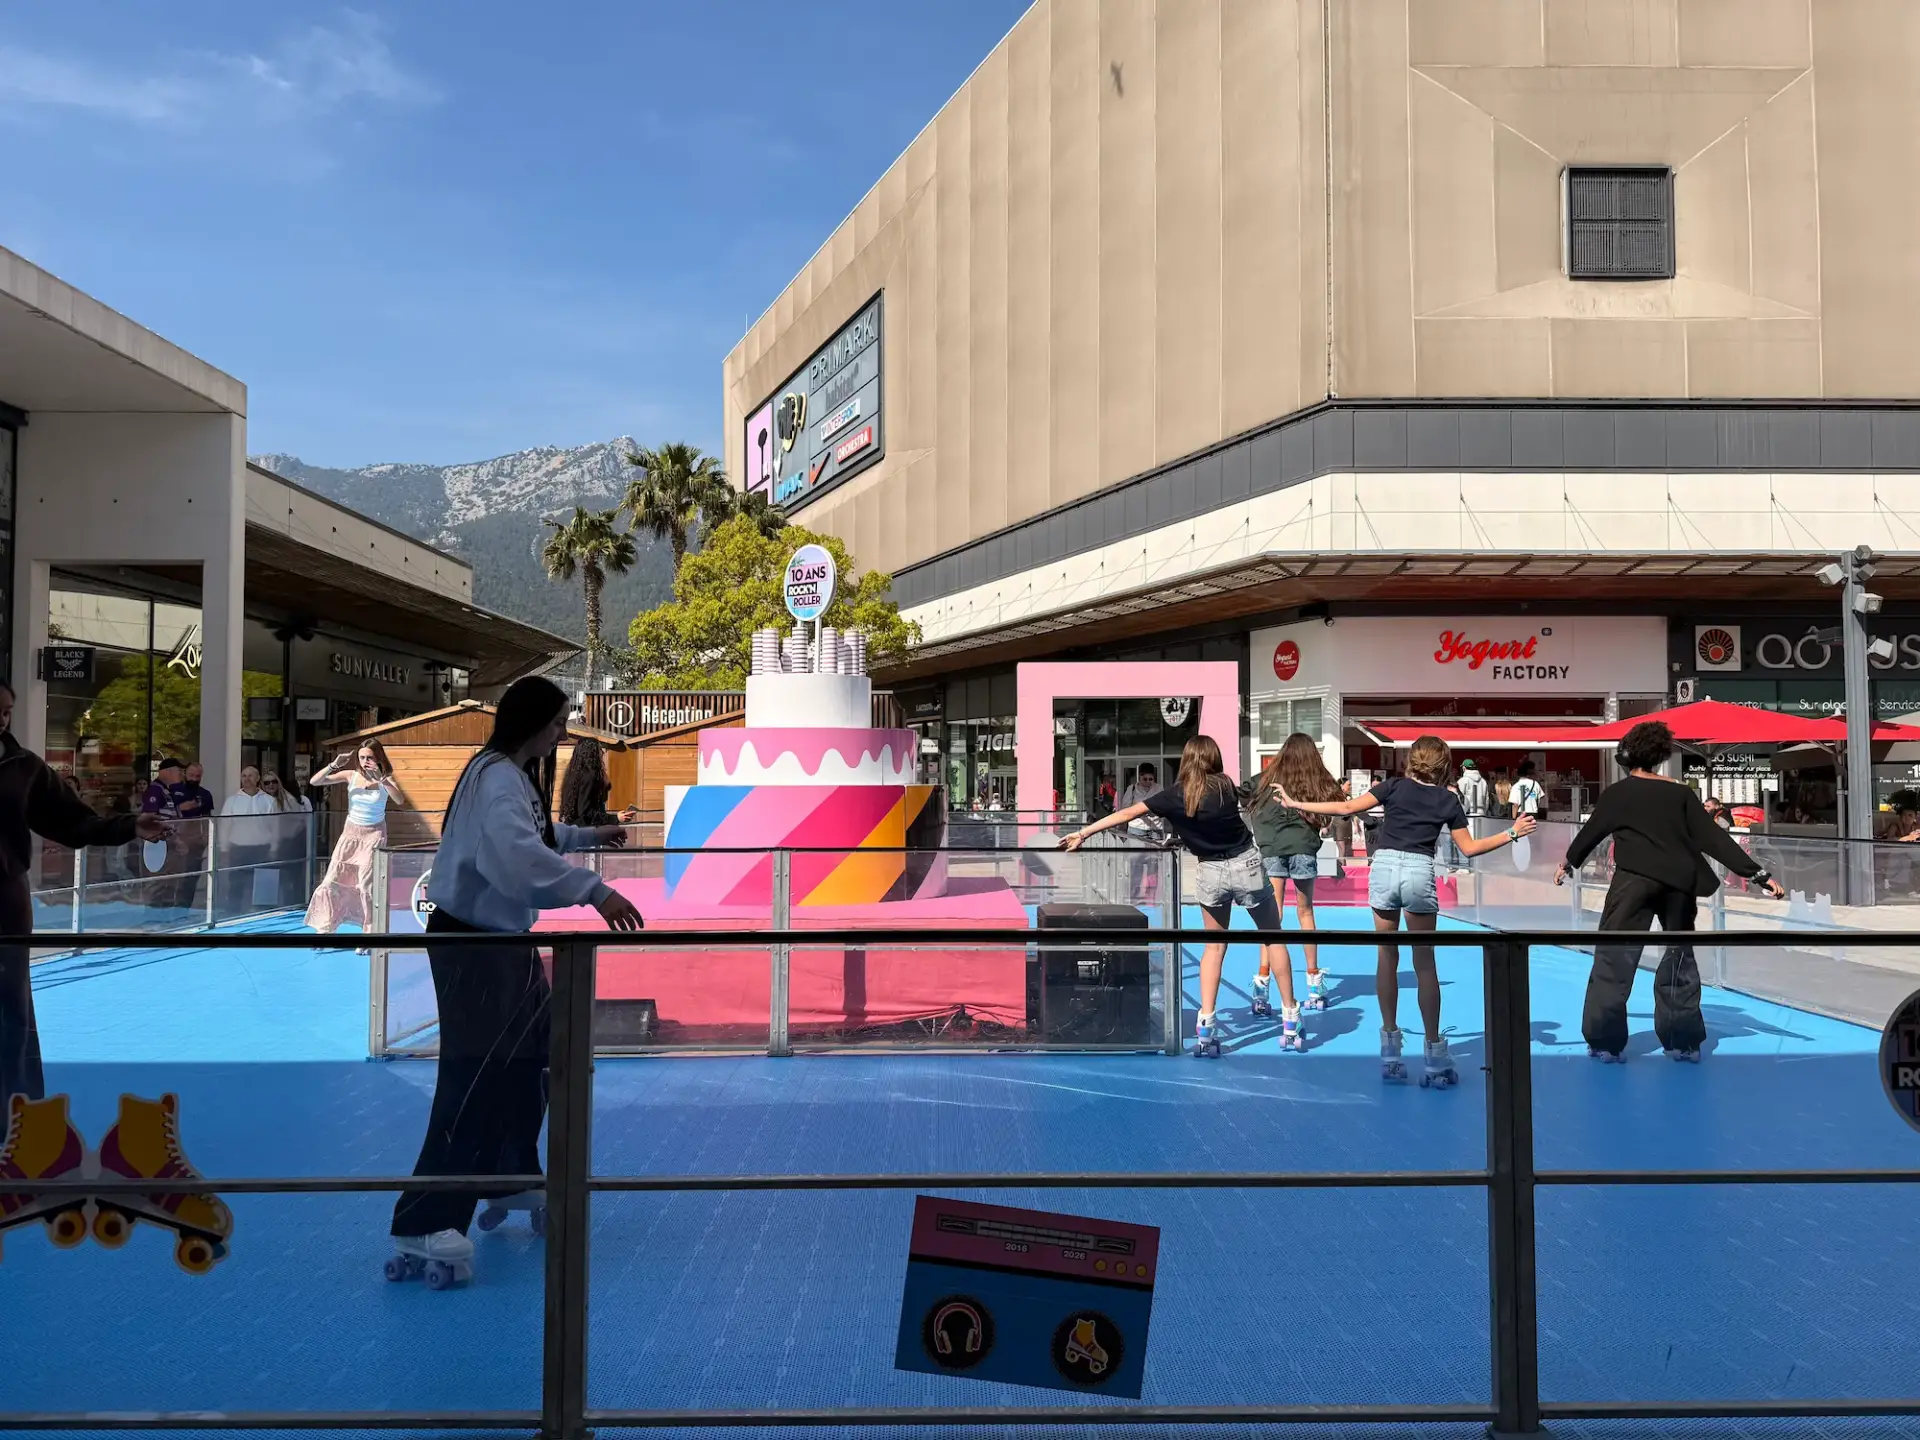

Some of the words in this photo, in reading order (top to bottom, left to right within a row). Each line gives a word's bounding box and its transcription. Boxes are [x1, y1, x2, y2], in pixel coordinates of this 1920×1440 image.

[811, 311, 875, 389] PRIMARK
[837, 431, 868, 461] ORCHESTRA
[791, 569, 803, 582] 10
[805, 566, 825, 580] ANS
[788, 584, 816, 596] ROCK'N
[793, 596, 820, 606] ROLLER
[55, 650, 85, 659] BLACKS
[1434, 630, 1538, 670] Yogurt
[1868, 634, 1920, 670] US
[53, 670, 85, 679] LEGEND
[334, 653, 411, 685] SUNVALLEY
[1493, 665, 1570, 680] FACTORY
[1799, 699, 1819, 710] Sur
[1822, 699, 1847, 712] plac
[642, 705, 712, 726] Réception
[977, 733, 1017, 751] TIGE
[1727, 753, 1754, 762] SUSHI
[1005, 1242, 1028, 1253] 2016
[1063, 1250, 1086, 1260] 2026
